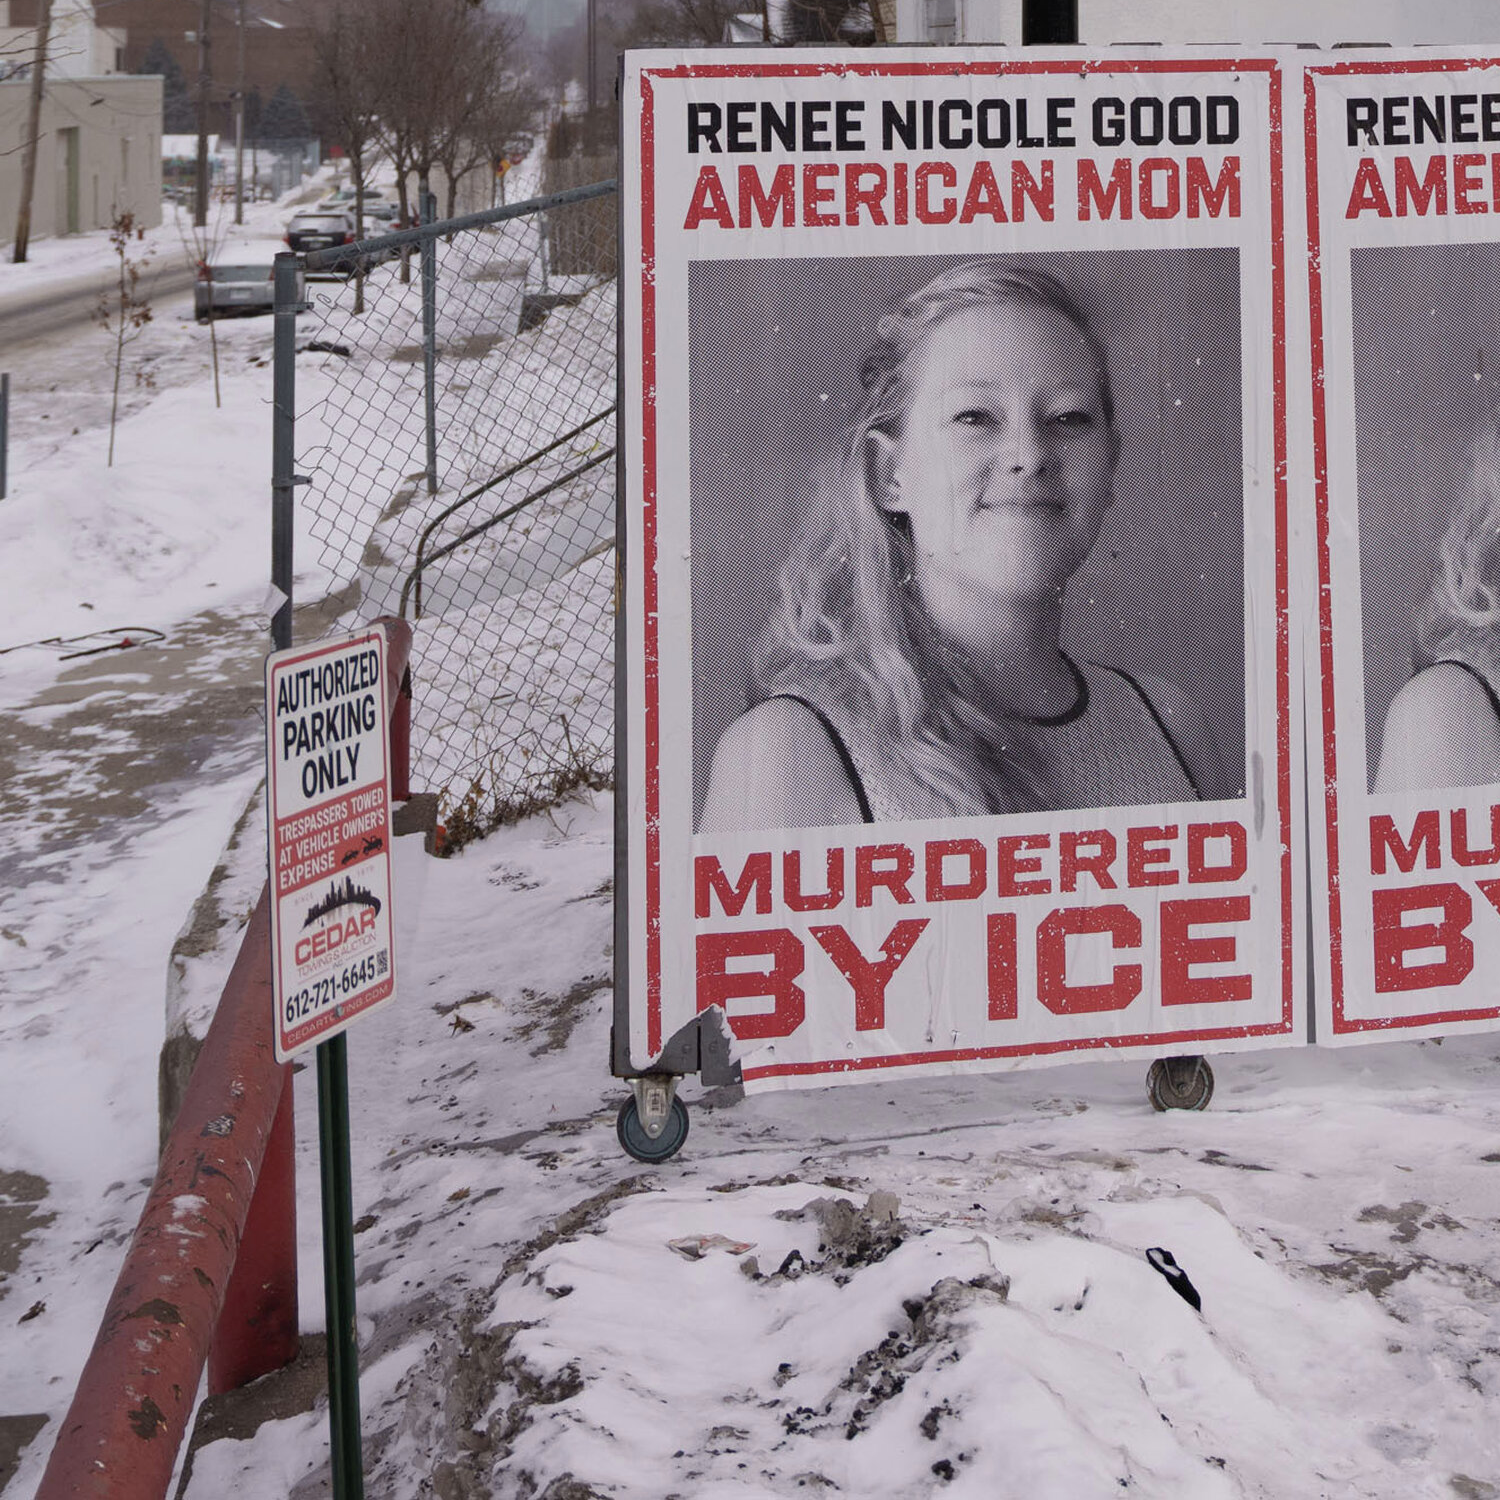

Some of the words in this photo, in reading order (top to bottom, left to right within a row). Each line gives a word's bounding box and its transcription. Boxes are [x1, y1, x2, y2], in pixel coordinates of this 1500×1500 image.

[687, 101, 866, 154] RENEE
[882, 97, 1076, 151] NICOLE
[1092, 95, 1239, 148] GOOD
[683, 159, 1055, 230] AMERICAN
[1076, 155, 1241, 222] MOM
[277, 649, 379, 718] AUTHORIZED
[284, 694, 375, 761] PARKING
[302, 742, 360, 799] ONLY
[279, 801, 348, 844] TRESPASSERS
[350, 787, 384, 815] TOWED
[280, 846, 293, 868] AT
[296, 826, 340, 860] VEHICLE
[342, 808, 385, 840] OWNER'S
[280, 850, 336, 890] EXPENSE
[694, 821, 1248, 919] MURDERED
[295, 906, 375, 967] CEDAR
[695, 918, 930, 1041] BY
[986, 895, 1253, 1021] ICE
[286, 955, 375, 1023] 612-721-6645
